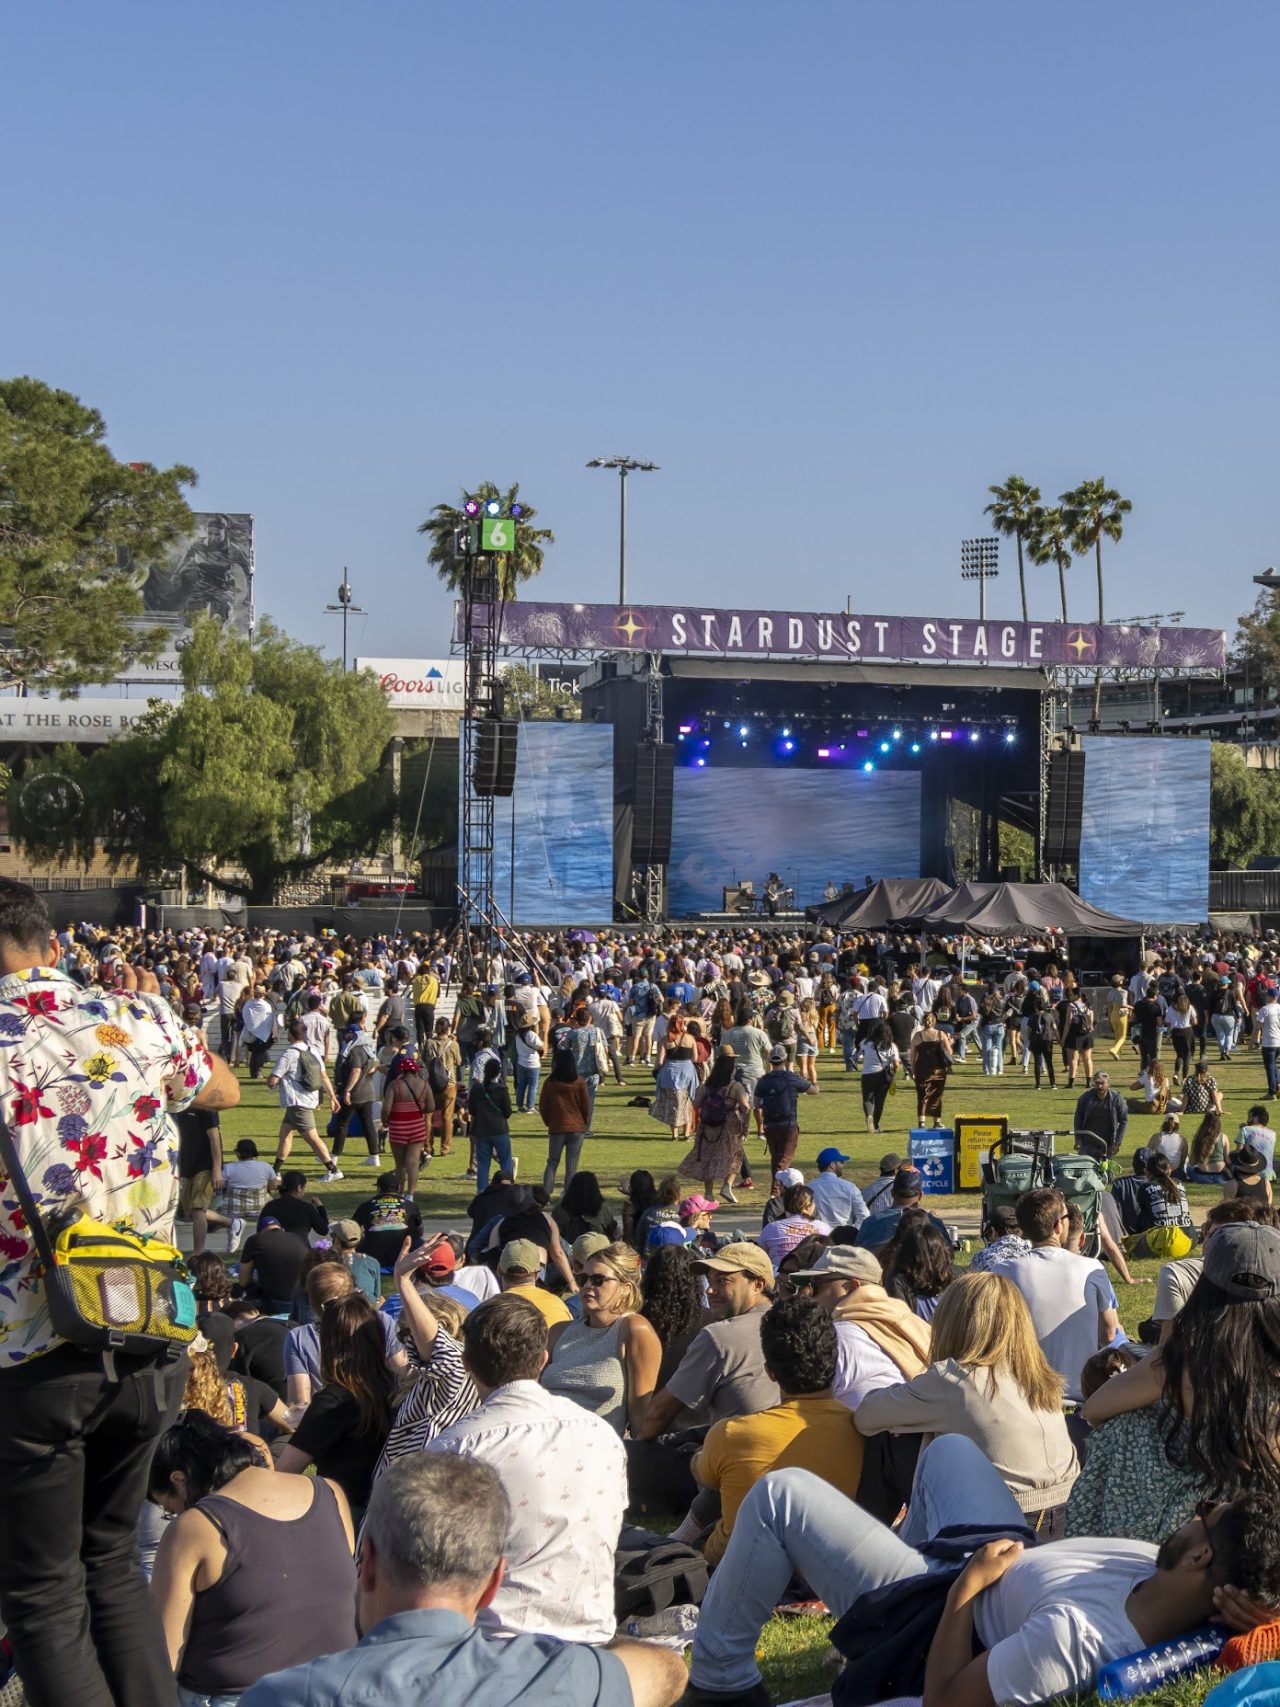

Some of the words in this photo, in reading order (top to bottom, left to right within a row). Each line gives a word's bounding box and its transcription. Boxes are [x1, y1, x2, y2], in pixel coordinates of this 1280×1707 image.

[490, 522, 507, 547] 6
[671, 612, 889, 653] STARDUST
[922, 622, 1044, 659] STAGE
[145, 660, 183, 672] WESC
[379, 673, 435, 694] Coors
[23, 714, 62, 727] THE
[68, 714, 112, 728] ROSE
[119, 715, 143, 728] BO
[973, 1129, 992, 1137] Please
[921, 1179, 949, 1188] ECYCLE
[1145, 1184, 1162, 1195] The
